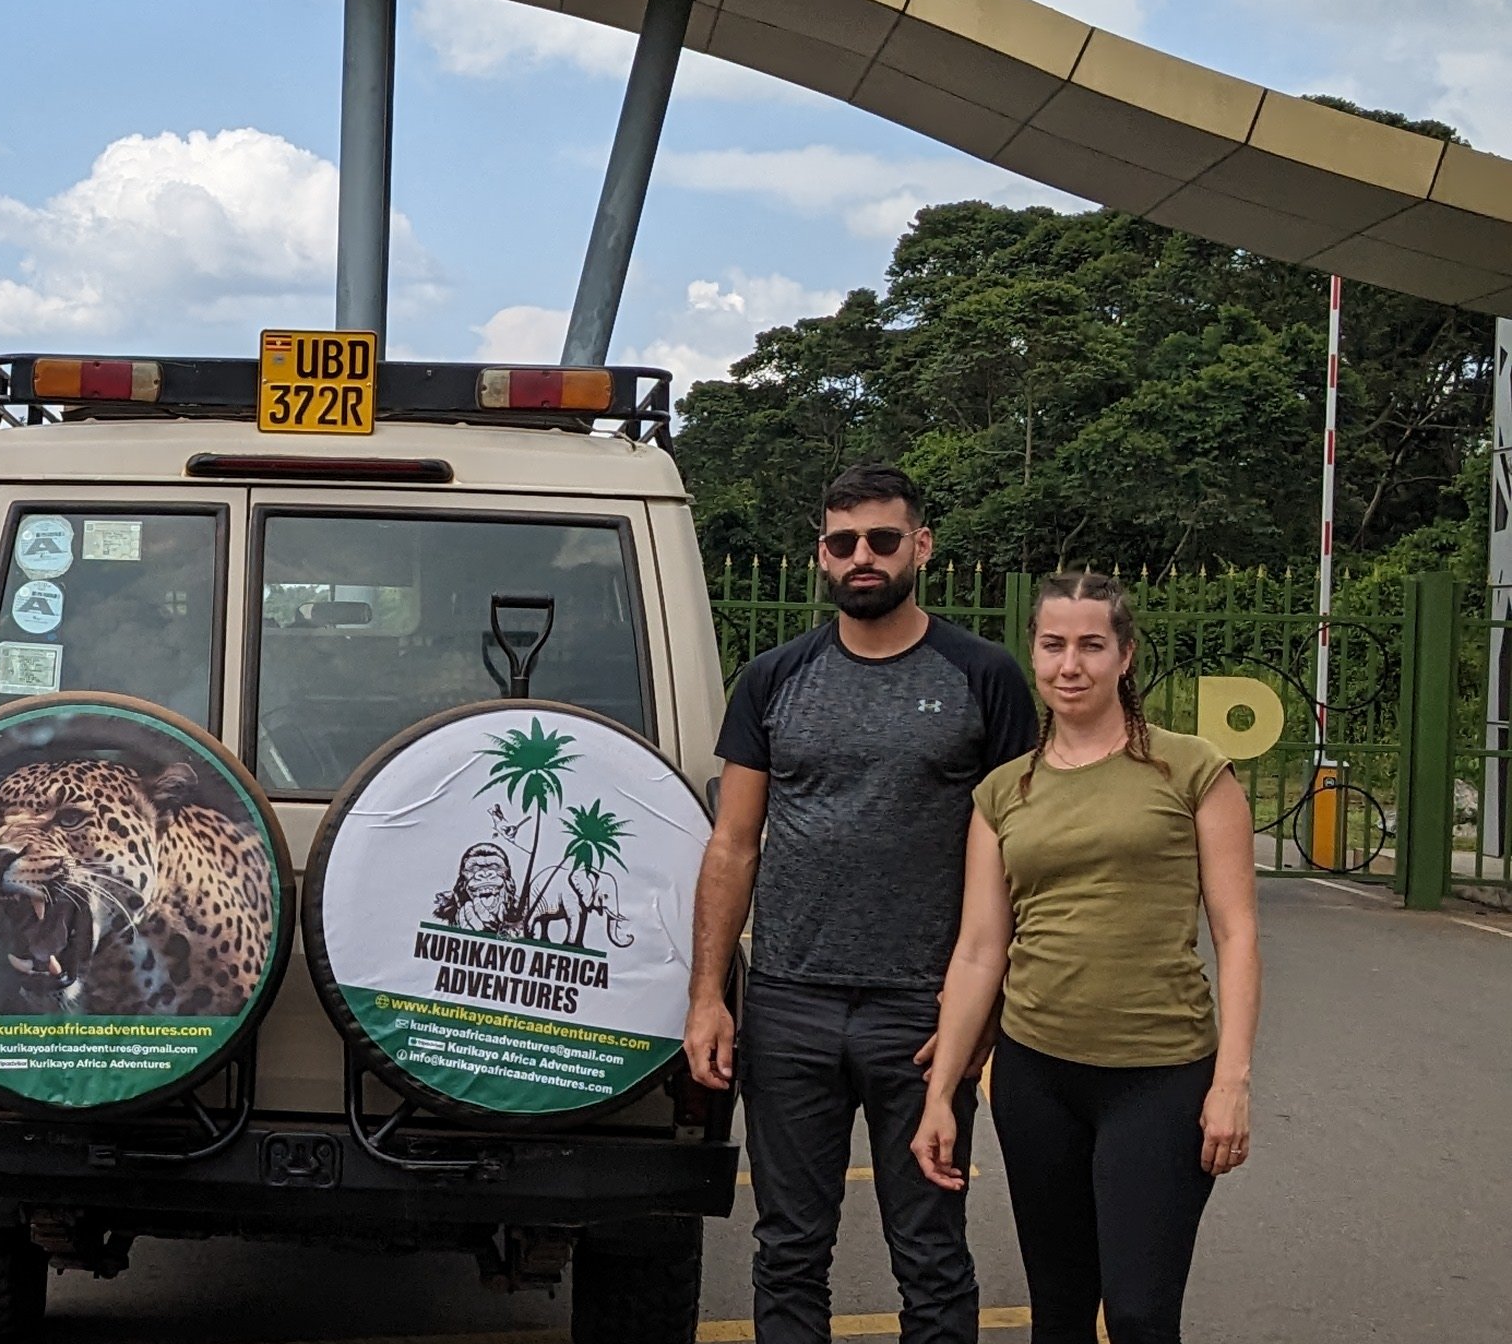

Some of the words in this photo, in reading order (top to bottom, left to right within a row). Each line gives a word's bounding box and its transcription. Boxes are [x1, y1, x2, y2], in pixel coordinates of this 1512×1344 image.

[296, 339, 370, 379] UBD
[269, 384, 363, 426] 372R
[413, 931, 525, 975] KURIKAYO
[528, 951, 609, 989] AFRICA
[434, 965, 580, 1014] ADVENTURES
[391, 997, 651, 1051] www.kurikayoafricaadventures.com
[409, 1018, 624, 1065] kurikayoafricaadventures@gmail.com
[0, 1043, 198, 1055] kurikayoafricaadventures@gmail.com
[29, 1059, 75, 1070] Kurikayo
[76, 1059, 107, 1069] Africa
[109, 1059, 172, 1069] Adventures
[447, 1041, 499, 1061] Kurikayo
[500, 1050, 537, 1067] Africa
[538, 1057, 606, 1079] Adventures
[409, 1050, 613, 1095] info@kurikayoafricaadventures.com
